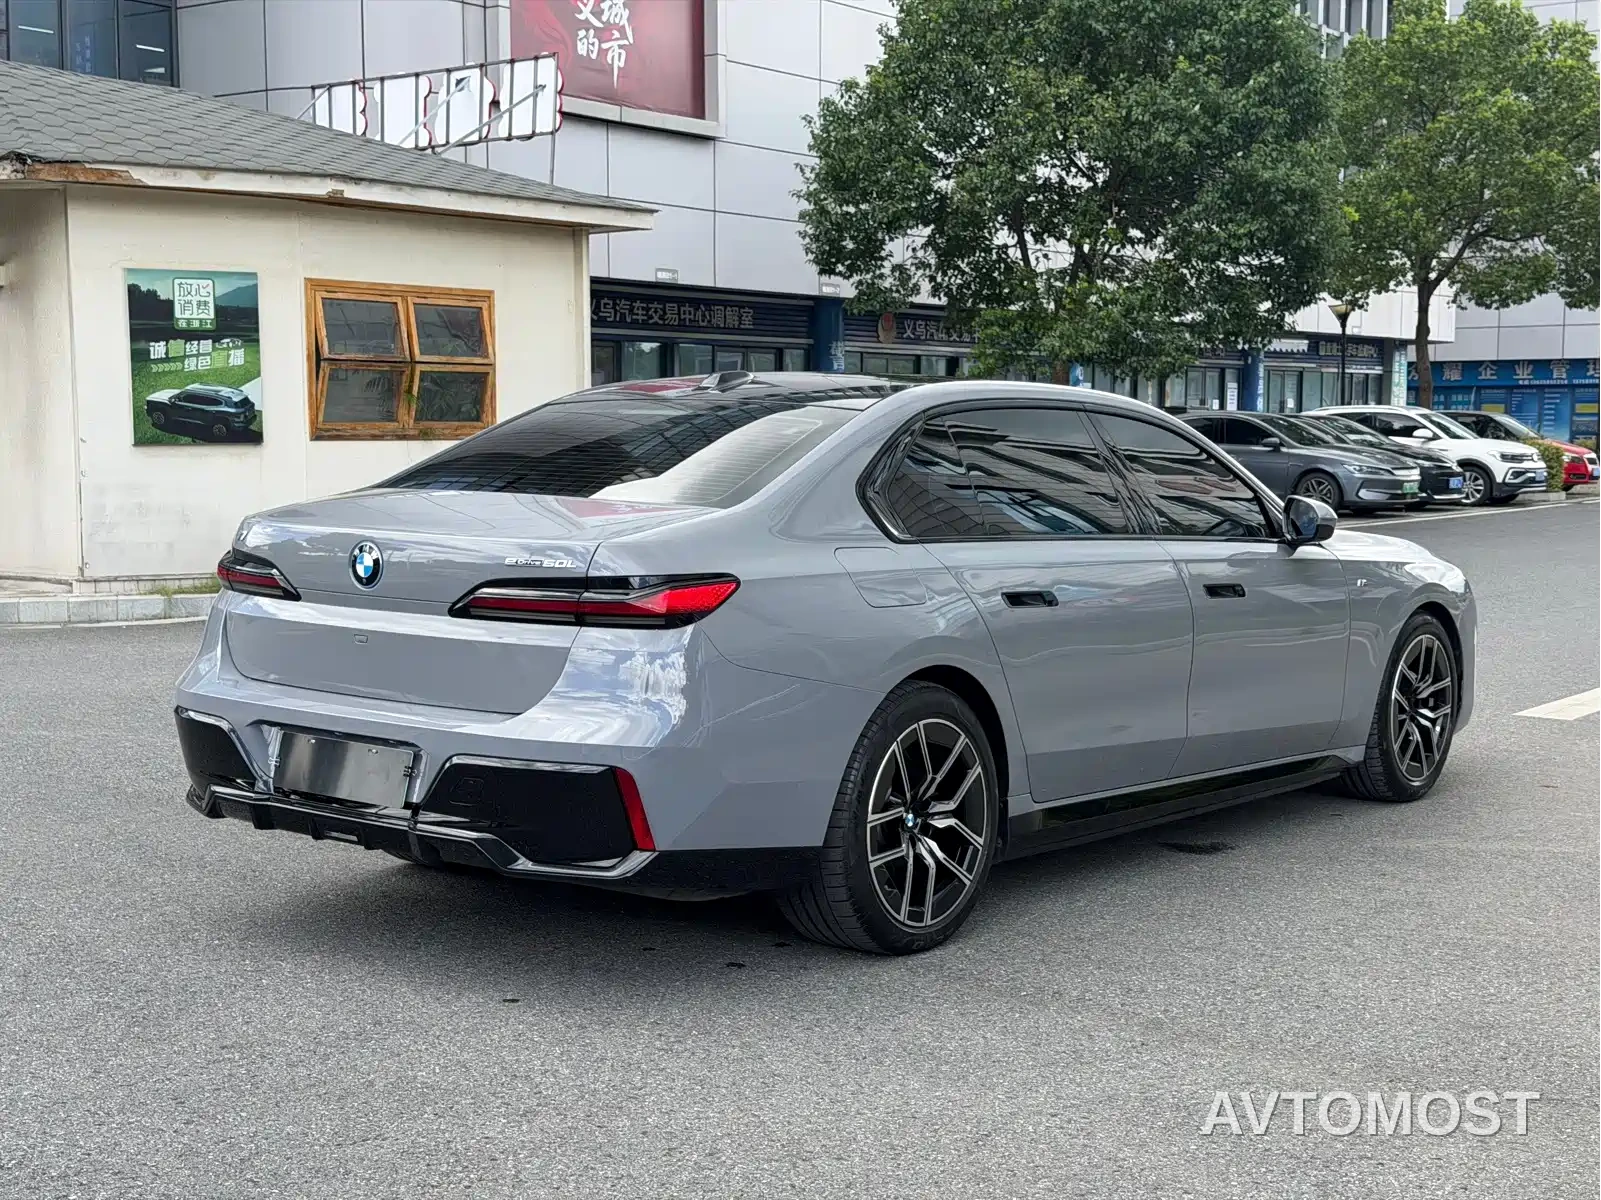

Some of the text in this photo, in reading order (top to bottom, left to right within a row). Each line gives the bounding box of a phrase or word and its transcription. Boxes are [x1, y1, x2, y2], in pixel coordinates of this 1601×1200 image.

[177, 281, 211, 297] 放心
[177, 299, 211, 316] 消费
[177, 319, 213, 328] 在浙江
[149, 339, 213, 359] 诚信经营
[184, 348, 245, 371] 绿色直播
